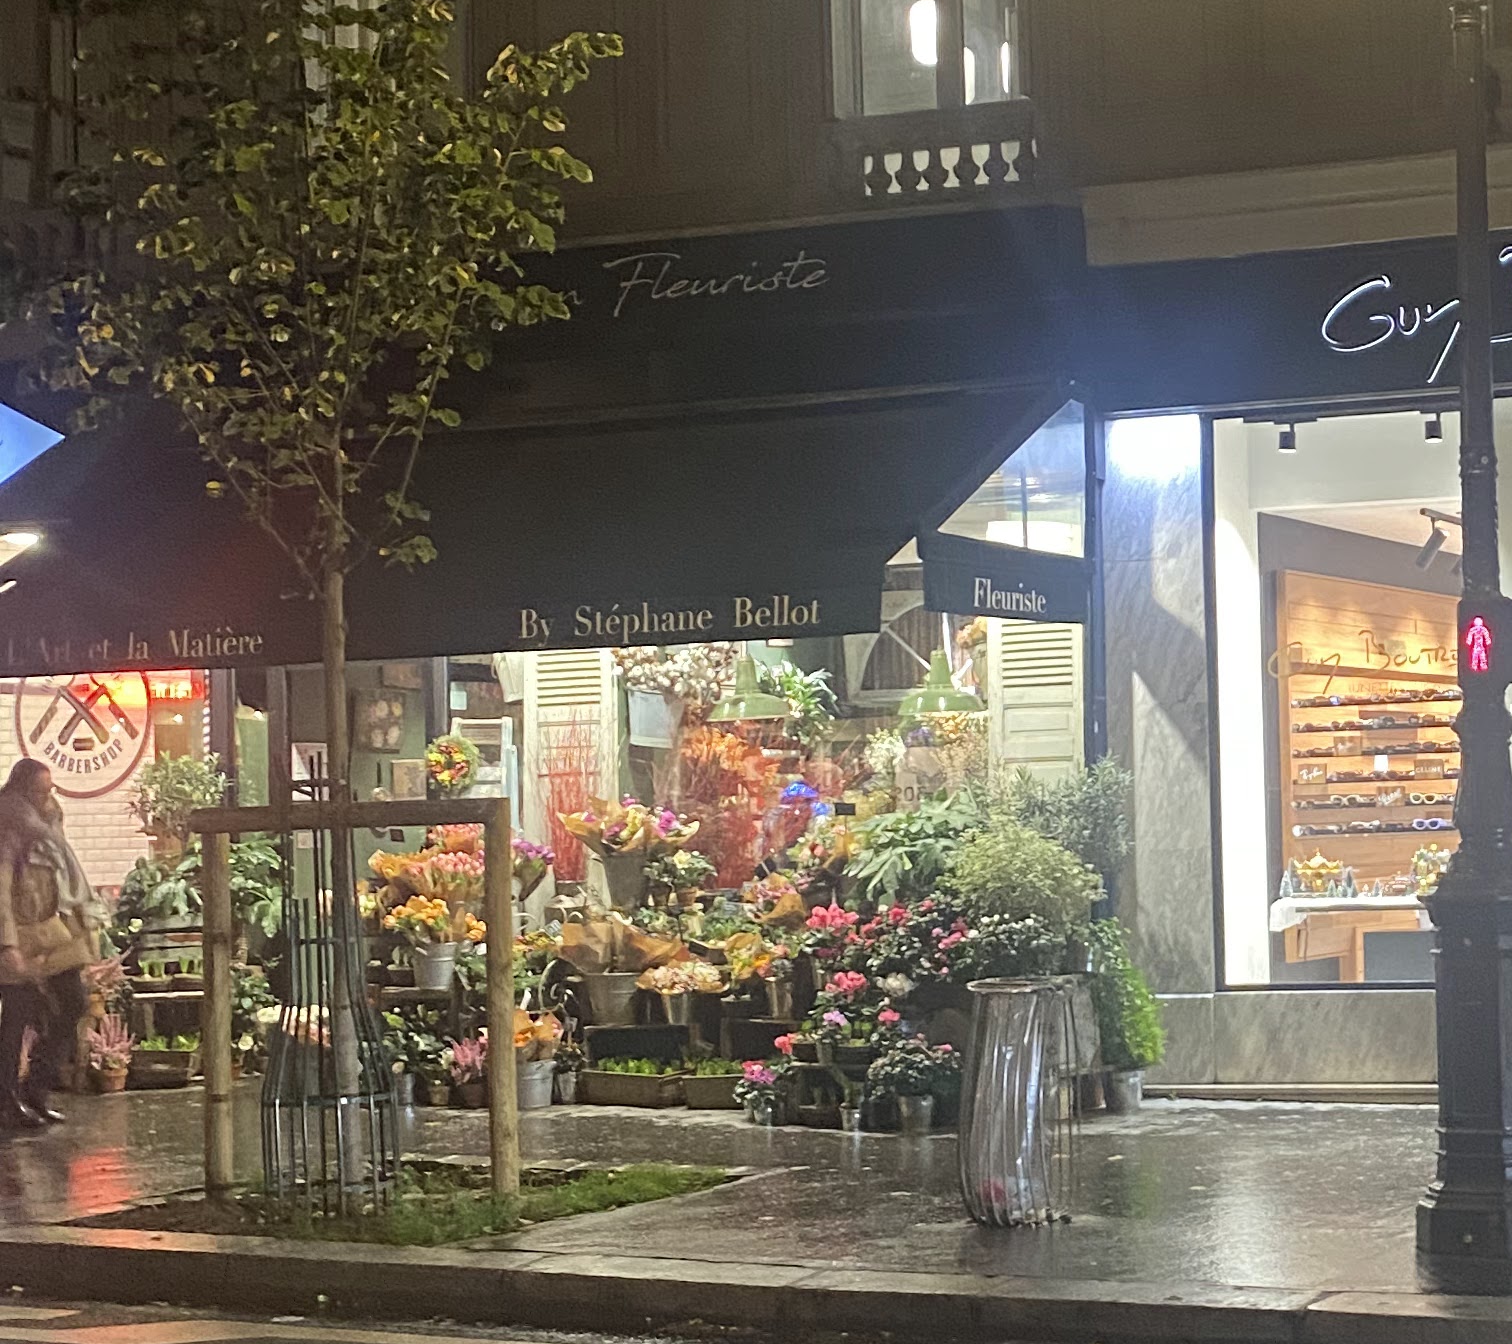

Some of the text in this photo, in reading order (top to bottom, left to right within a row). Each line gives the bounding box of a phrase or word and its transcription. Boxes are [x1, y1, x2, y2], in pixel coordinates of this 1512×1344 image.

[602, 250, 830, 317] Fleuriste
[973, 576, 1047, 614] Fleuriste
[518, 594, 821, 646] By Stéphane Bellot
[88, 638, 112, 661] et
[127, 631, 151, 661] la
[169, 626, 263, 659] Matière
[43, 737, 124, 774] BARBERSHOP
